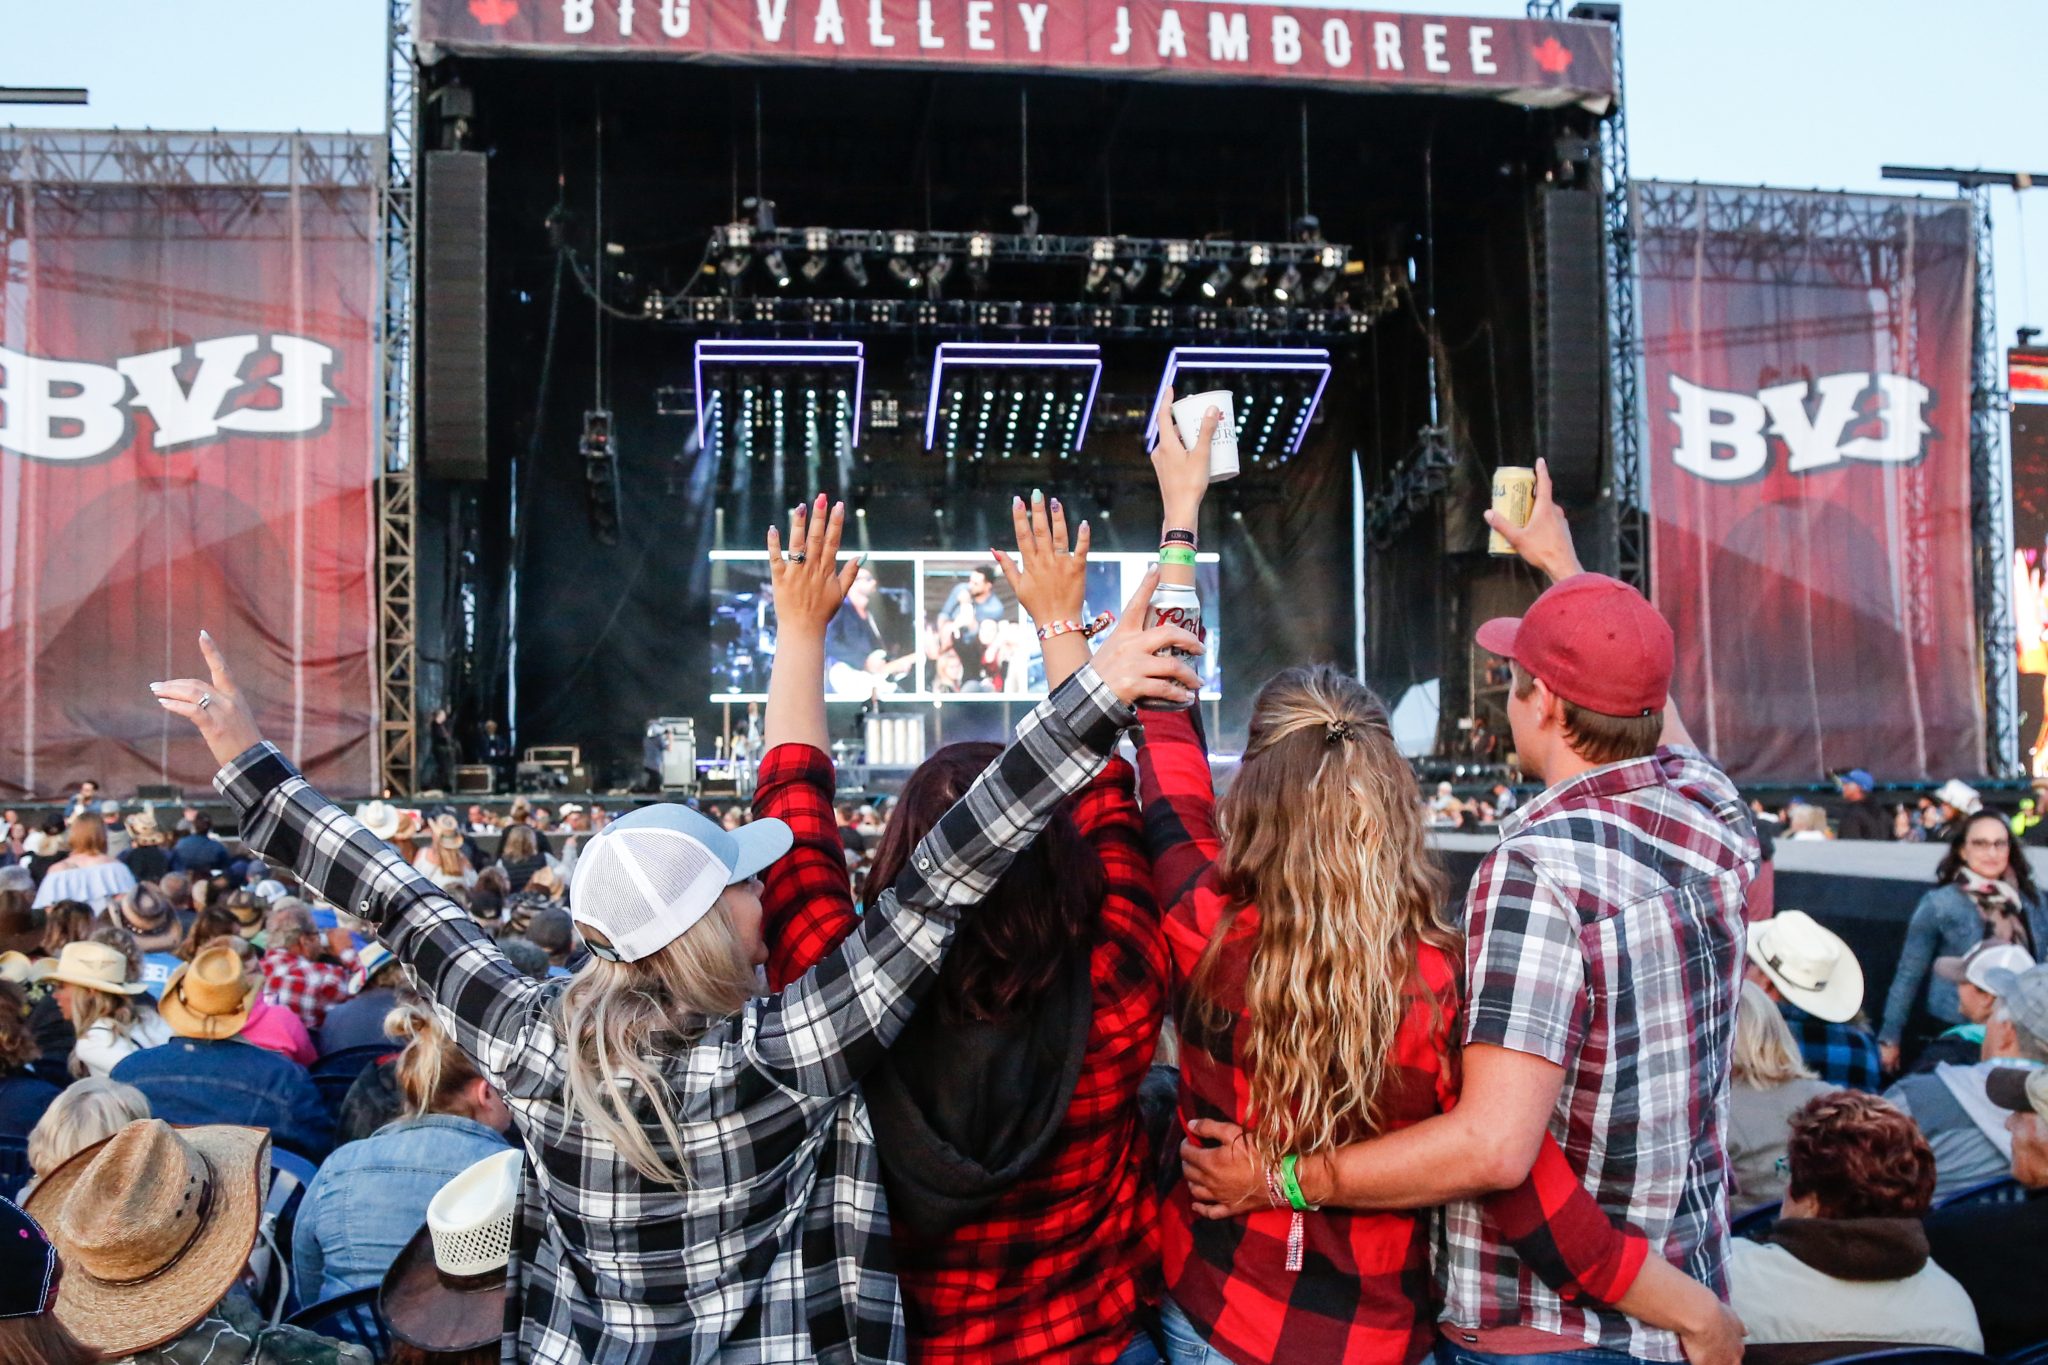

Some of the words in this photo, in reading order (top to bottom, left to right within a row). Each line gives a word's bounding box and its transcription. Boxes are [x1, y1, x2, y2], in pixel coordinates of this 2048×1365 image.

[561, 0, 691, 38] BIG
[756, 0, 1048, 52] VALLEY
[1110, 6, 1498, 75] JAMBOREE
